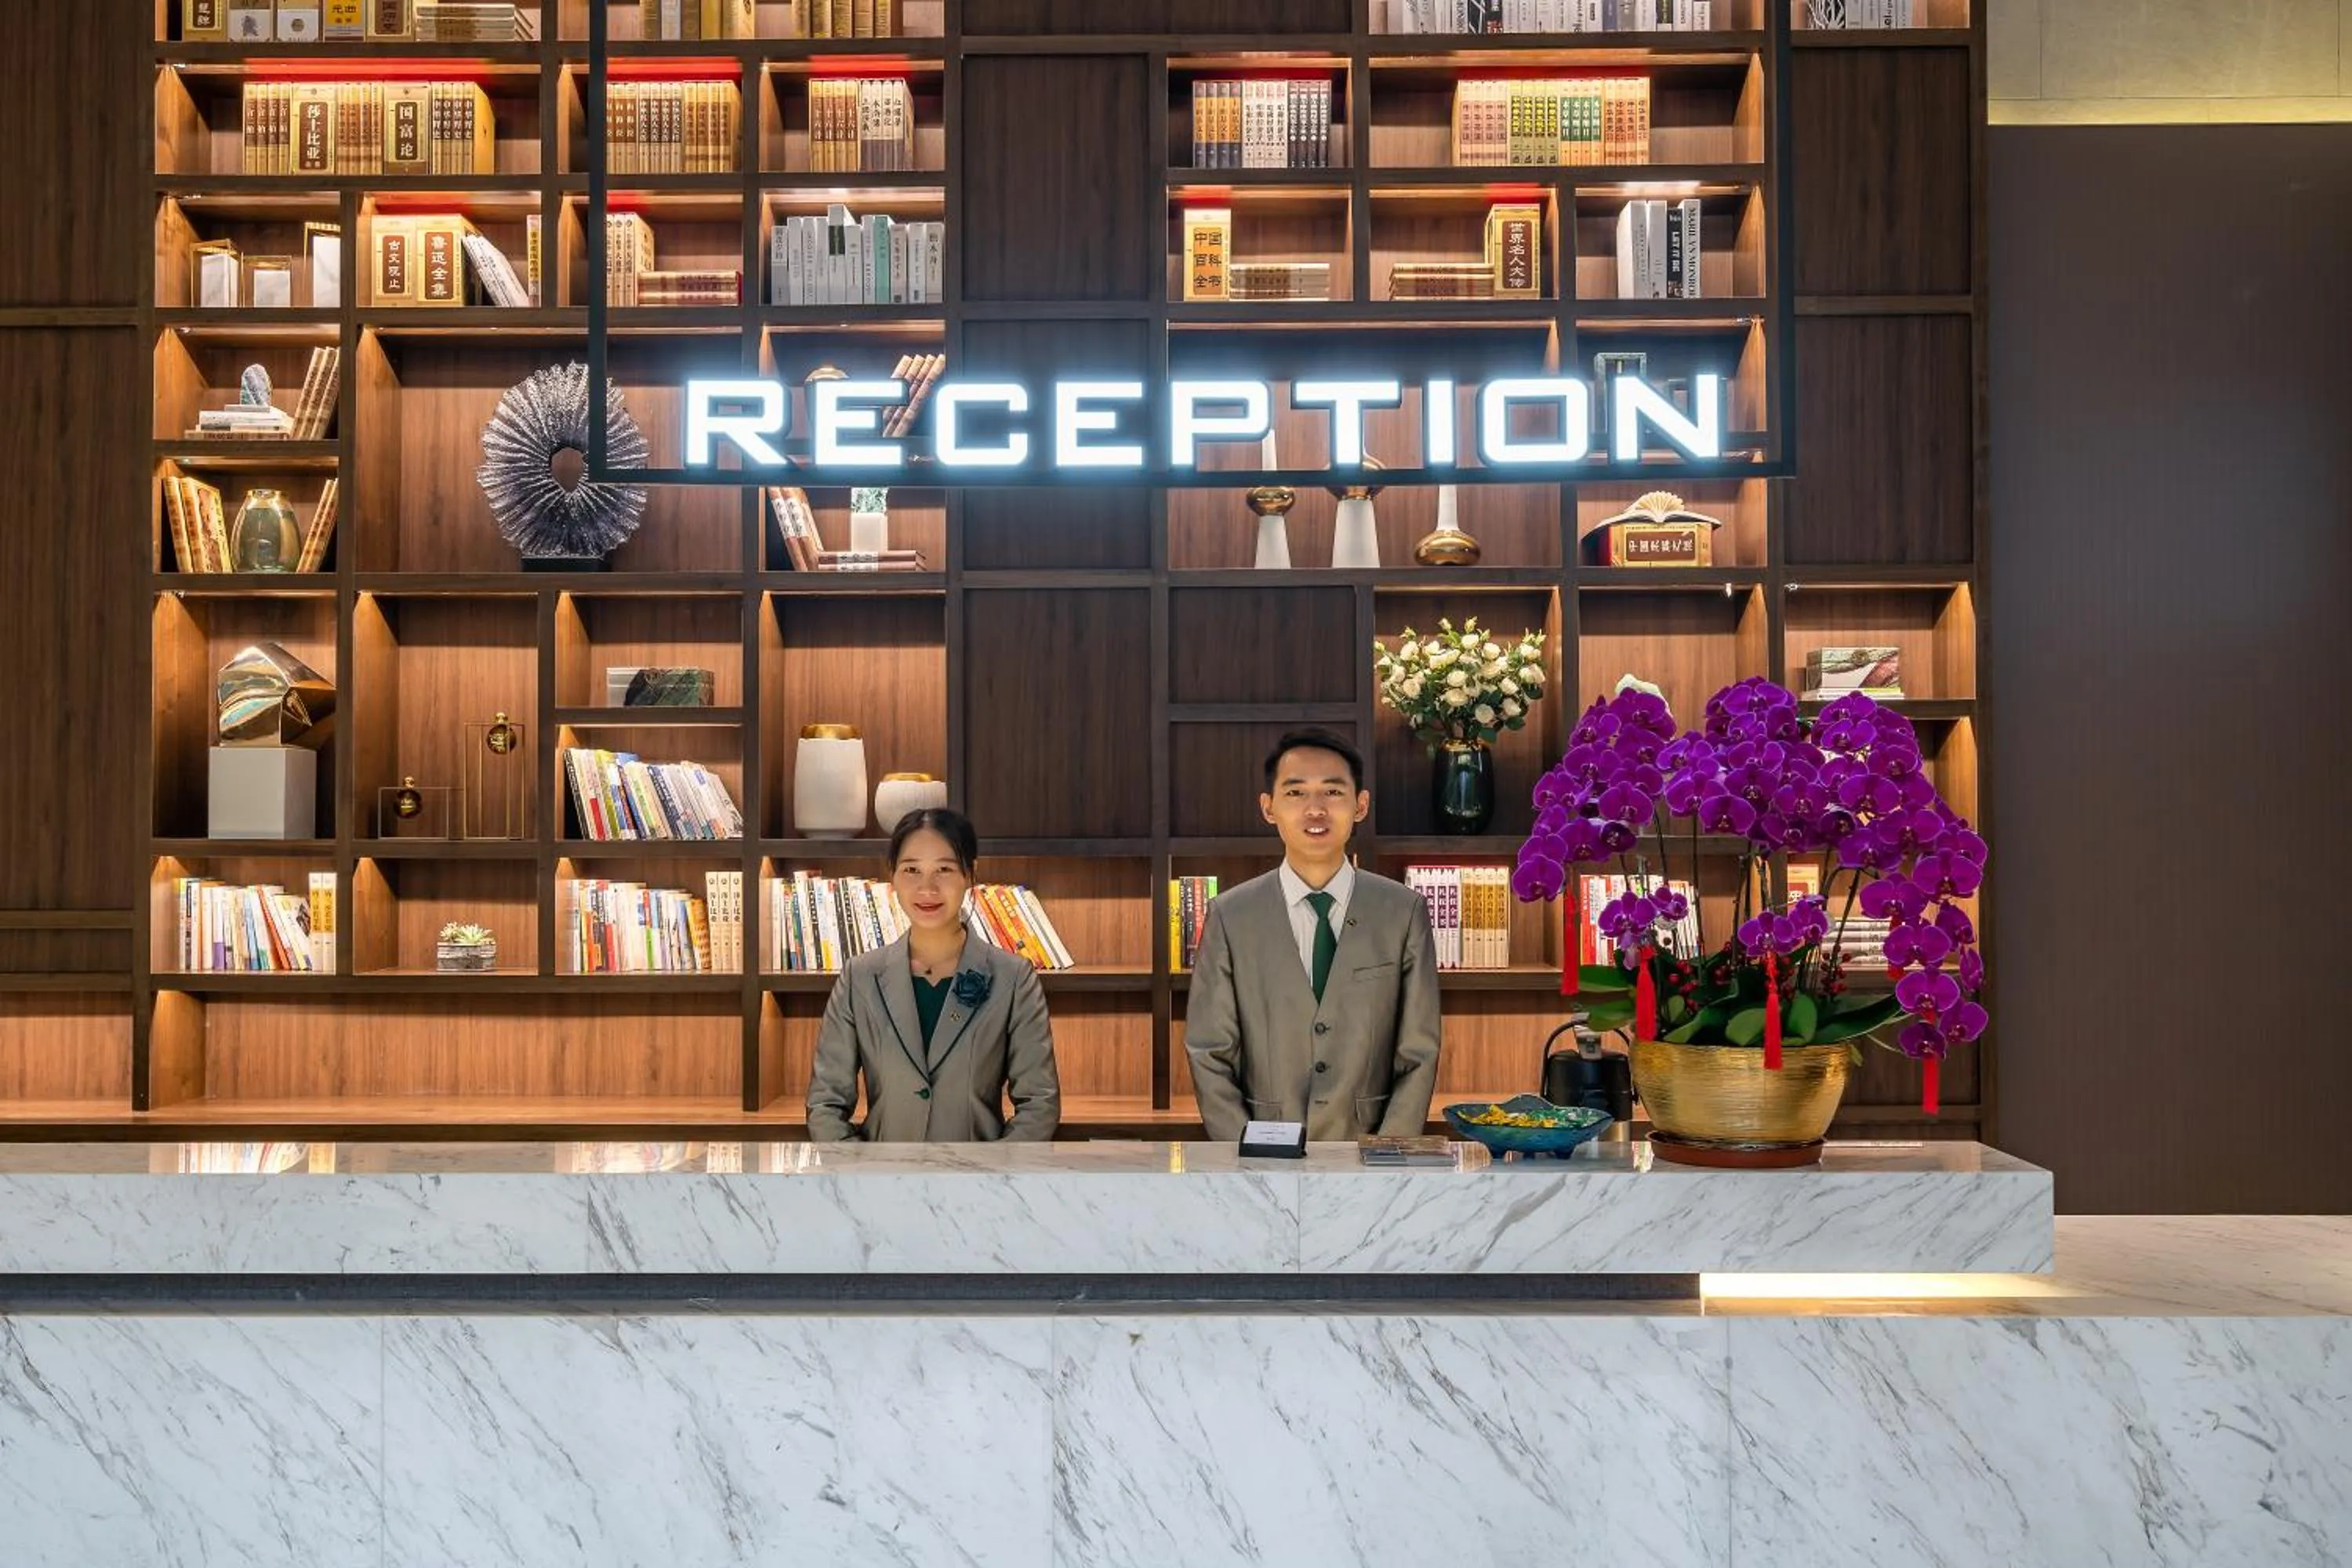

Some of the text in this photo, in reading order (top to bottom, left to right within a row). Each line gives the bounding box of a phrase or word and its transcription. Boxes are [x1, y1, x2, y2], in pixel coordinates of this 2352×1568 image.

[399, 105, 413, 156] 国富论
[1194, 232, 1222, 246] 中国
[1194, 253, 1222, 267] 百科
[388, 241, 401, 289] 古文观止
[431, 235, 448, 296] 鲁迅全集
[1194, 275, 1222, 288] 全书
[687, 375, 1719, 466] RECEPTION
